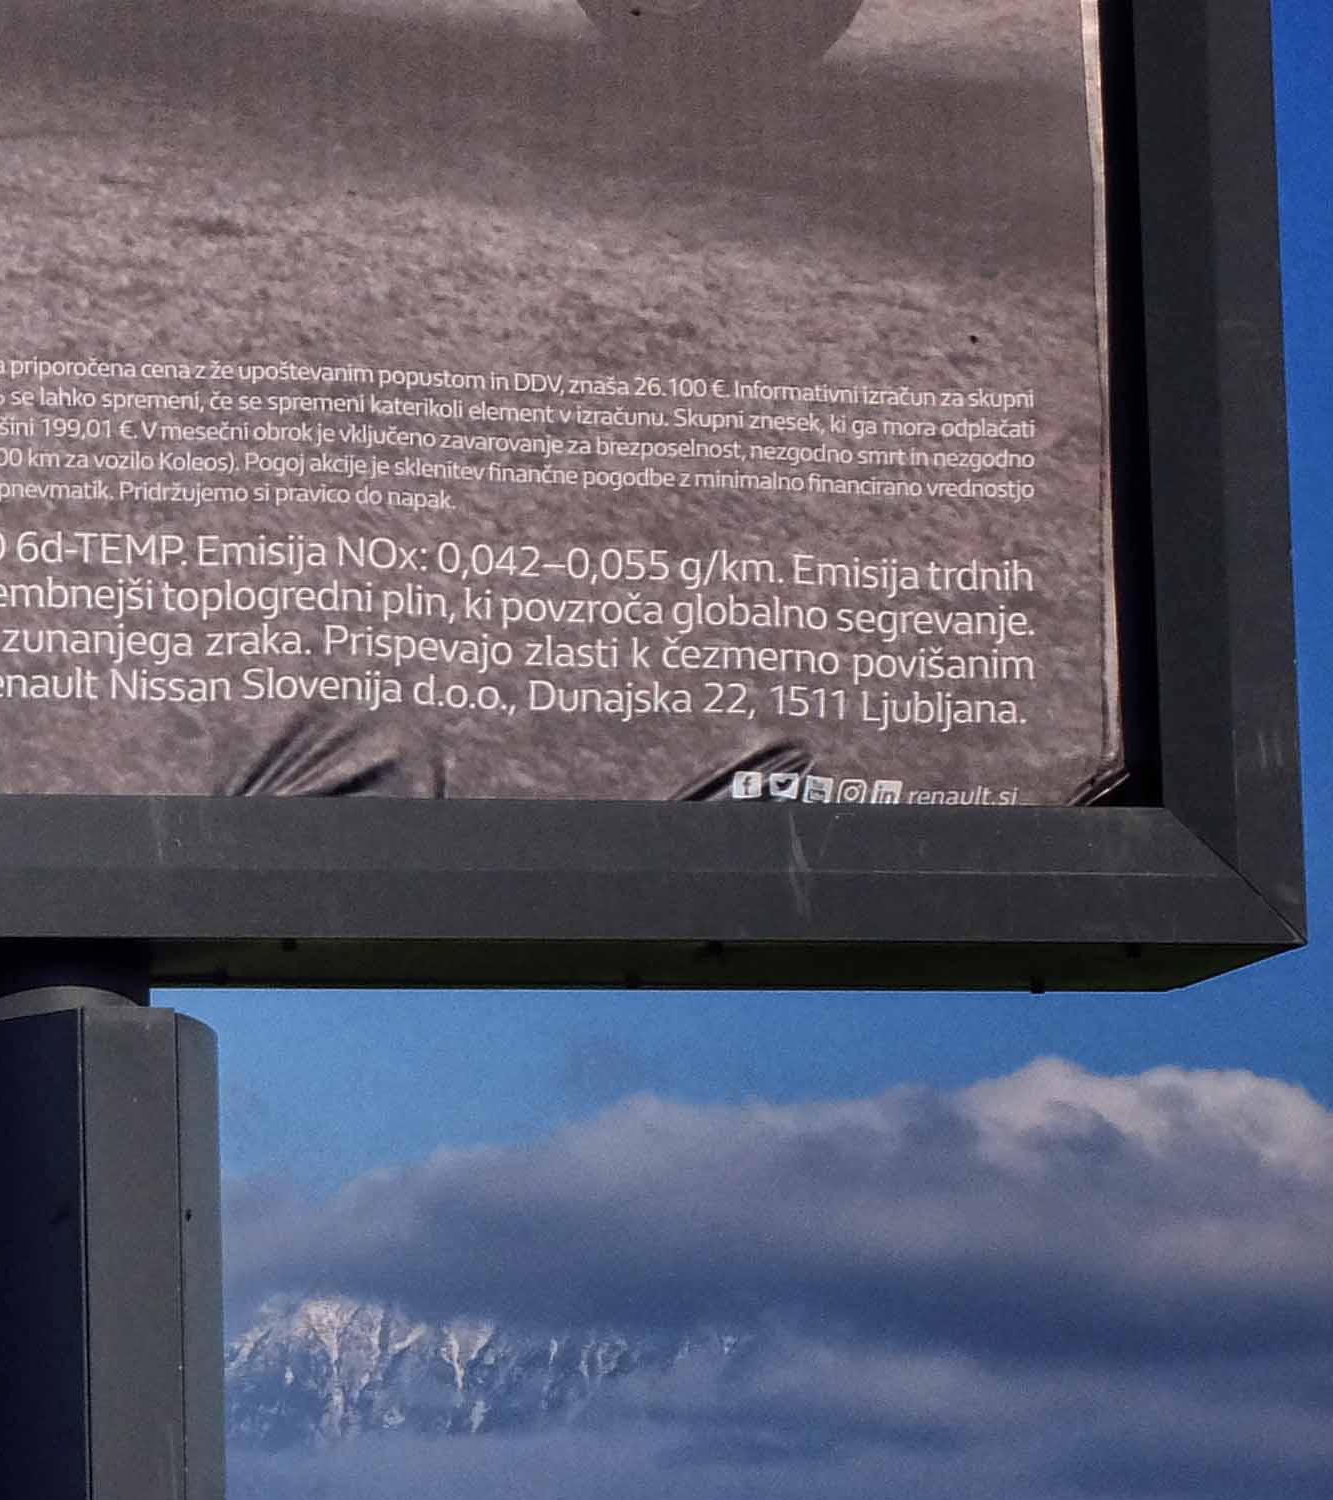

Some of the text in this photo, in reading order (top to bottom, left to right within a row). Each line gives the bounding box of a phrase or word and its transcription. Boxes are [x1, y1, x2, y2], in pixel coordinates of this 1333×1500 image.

[10, 355, 137, 382] priporočena
[140, 363, 191, 380] cena
[194, 365, 206, 380] z
[209, 360, 234, 380] že
[238, 361, 374, 388] upoštevanim
[378, 367, 486, 393] popustom
[490, 370, 510, 391] in
[514, 372, 565, 395] DDV,
[568, 374, 630, 396] znaša
[634, 376, 708, 398] 26.100
[734, 379, 859, 404] Informativni
[862, 385, 937, 407] izračun
[940, 392, 964, 408] za
[967, 388, 1034, 413] skupni
[16, 531, 188, 565] 6d-TEMP.
[197, 534, 327, 574] Emisija
[338, 536, 428, 572] NOx:
[678, 550, 785, 591] g/km.
[793, 553, 920, 596] Emisija
[926, 558, 1034, 591] trdnih
[162, 579, 373, 620] toplogredni
[383, 582, 460, 626] plin,
[464, 588, 492, 621] ki
[500, 589, 664, 631] povzroča
[671, 593, 828, 637] globalno
[836, 599, 1035, 641] segrevanje.
[1, 621, 193, 662] zunanjega
[205, 624, 312, 656] zraka.
[323, 625, 514, 672] Prispevajo
[524, 634, 618, 669] zlasti
[631, 637, 650, 669] k
[661, 637, 840, 675] čezmerno
[852, 644, 1035, 686] povišanim
[110, 668, 232, 702] Nissan
[242, 668, 403, 711] Slovenija
[412, 673, 516, 714] d.o.o.,
[528, 679, 693, 721] Dunajska
[702, 682, 756, 719] 22,
[770, 684, 849, 720] 1511
[862, 689, 1027, 731] Ljubljana.
[907, 786, 1019, 806] renault.si
